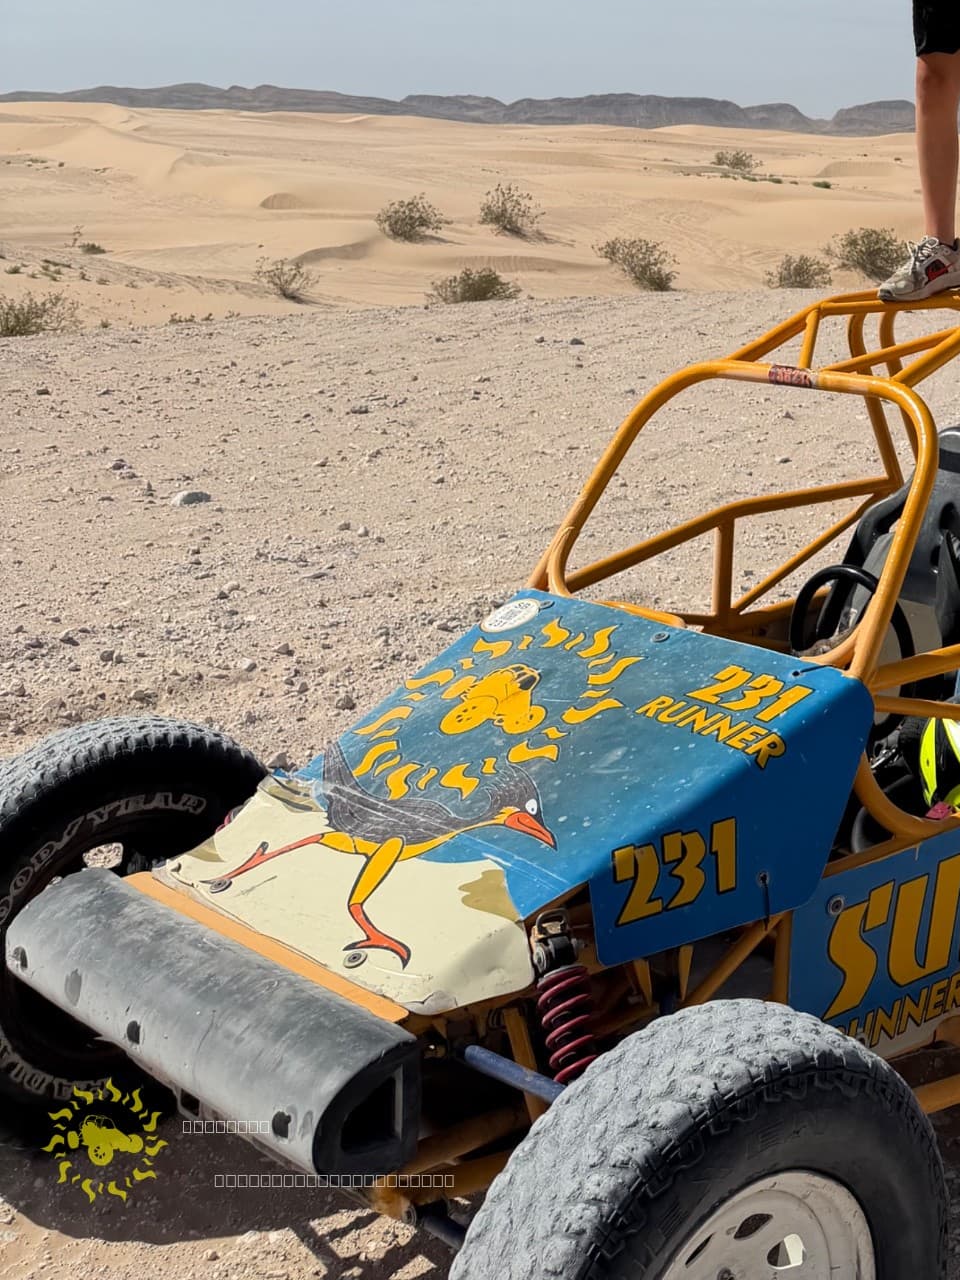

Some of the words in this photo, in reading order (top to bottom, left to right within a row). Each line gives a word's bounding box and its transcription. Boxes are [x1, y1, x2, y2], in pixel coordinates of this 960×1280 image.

[685, 664, 814, 722] 231
[634, 695, 786, 770] RUNNER
[611, 817, 738, 928] 231
